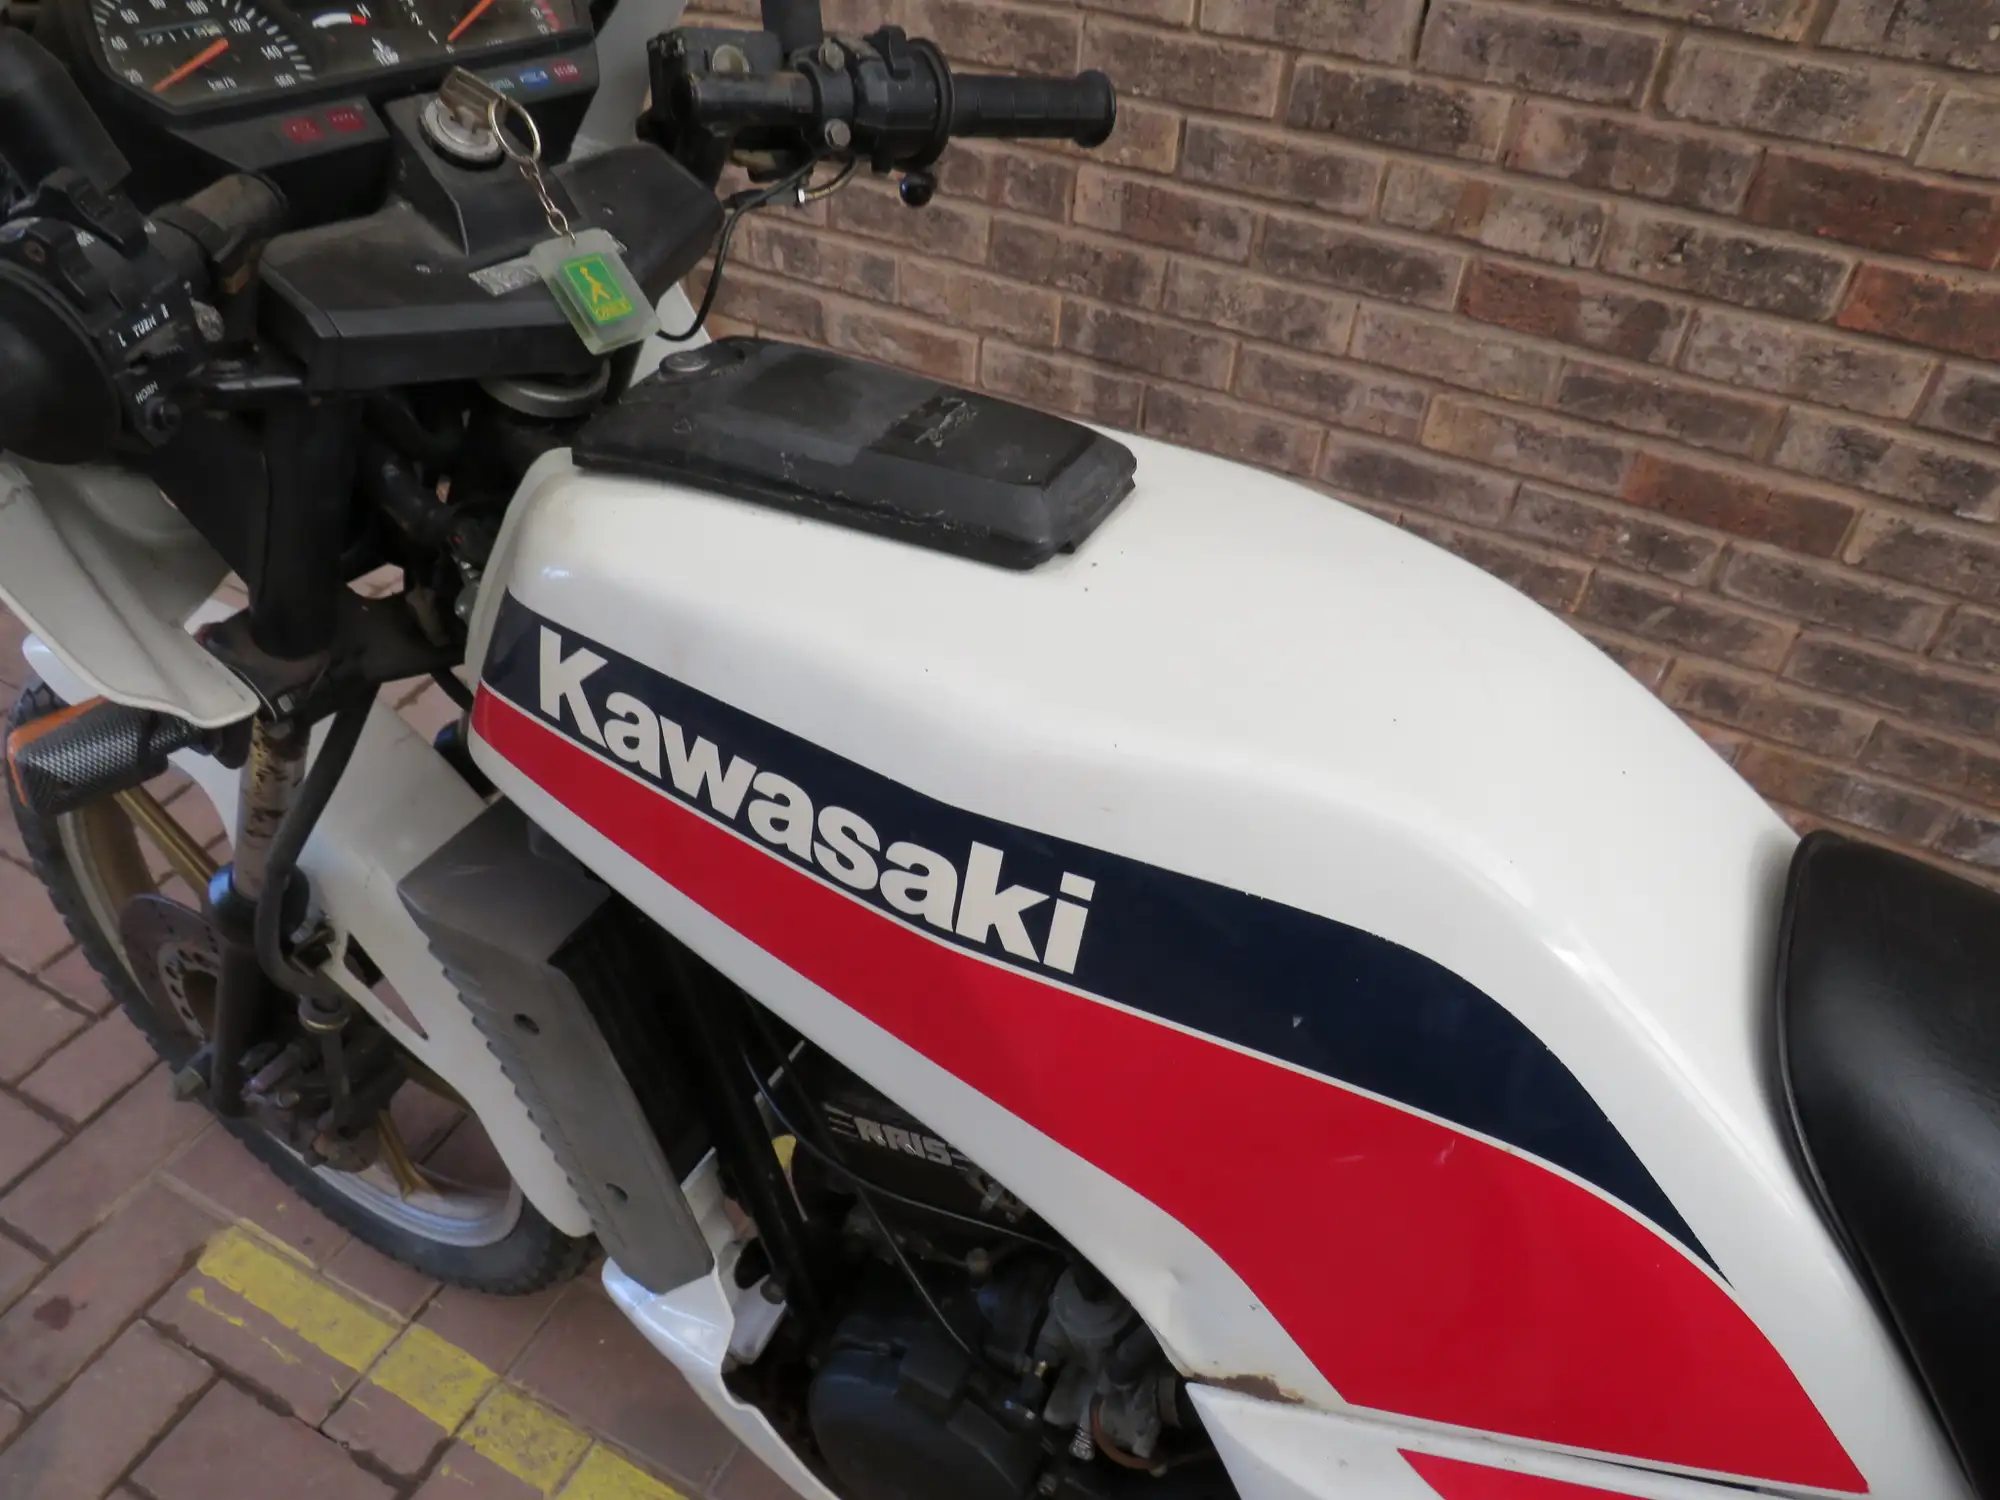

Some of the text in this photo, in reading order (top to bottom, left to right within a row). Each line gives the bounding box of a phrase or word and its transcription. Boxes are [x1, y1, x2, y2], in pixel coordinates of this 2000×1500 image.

[229, 18, 251, 33] 120
[207, 76, 236, 91] km/h
[132, 314, 157, 337] TURN
[135, 381, 158, 404] HORN
[540, 625, 1096, 975] Kawasaki
